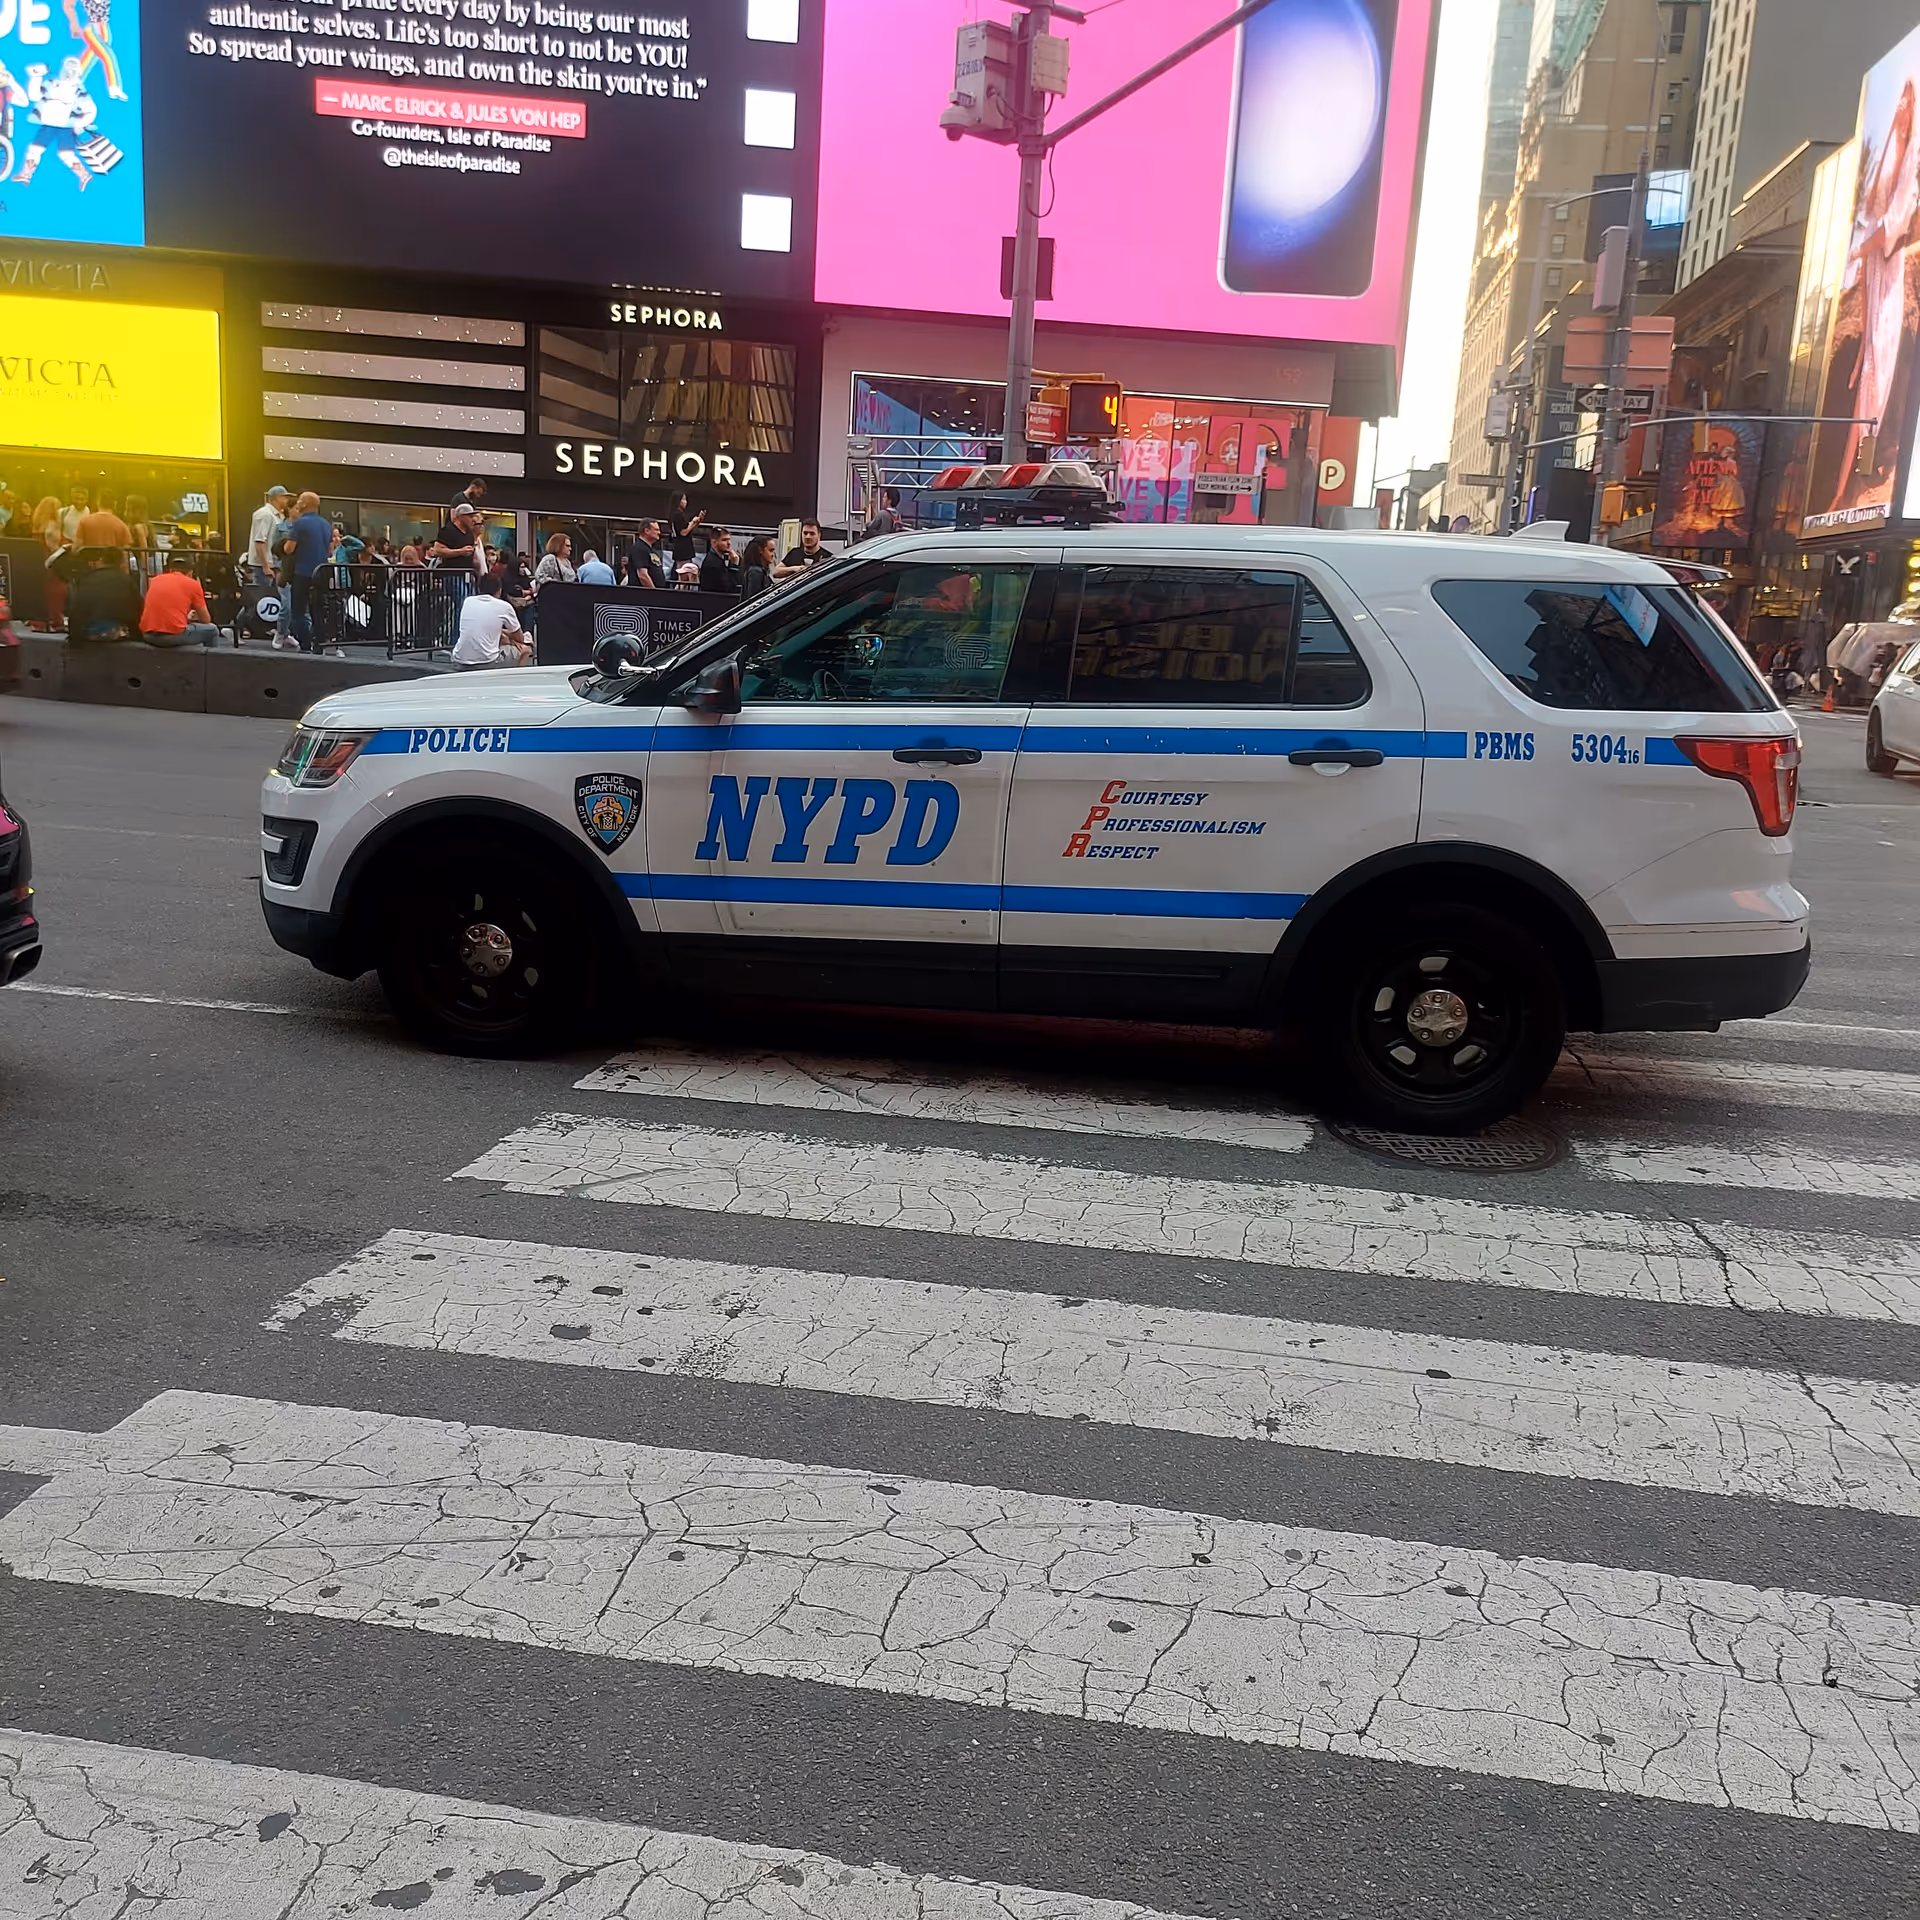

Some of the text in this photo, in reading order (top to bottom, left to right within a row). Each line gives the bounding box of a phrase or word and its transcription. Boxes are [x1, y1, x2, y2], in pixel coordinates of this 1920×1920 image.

[400, 0, 459, 21] every
[463, 0, 501, 25] day
[505, 0, 530, 28] by
[534, 1, 594, 34] being
[597, 15, 635, 33] our
[638, 15, 690, 39] most
[209, 5, 310, 33] authentic
[313, 12, 380, 41] selves.
[444, 26, 479, 49] too
[483, 28, 539, 56] short
[543, 35, 565, 58] to
[568, 38, 604, 61] not
[607, 38, 633, 64] be
[635, 43, 688, 69] YOU!
[188, 32, 217, 56] So
[220, 38, 292, 62] spread
[297, 47, 347, 68] your
[351, 45, 420, 77] wings,
[424, 55, 465, 79] and
[468, 62, 515, 84] own
[518, 61, 553, 87] the
[556, 65, 602, 92] skin
[342, 91, 392, 114] MARC
[395, 95, 447, 118] ELRICK
[450, 102, 464, 120] &
[466, 104, 508, 125] JULES
[510, 108, 548, 128] VON
[551, 111, 581, 130] HEP
[351, 118, 551, 153] Co-founders, Isle of Paradise
[383, 147, 521, 174] @theisleofparadise
[610, 303, 723, 330] SEPHORA
[1104, 396, 1118, 426] 4
[1586, 395, 1609, 407] ONE
[555, 442, 765, 488] SEPHORA
[1324, 466, 1337, 484] P
[261, 602, 280, 616] JD
[657, 620, 692, 632] TIMES
[411, 728, 507, 753] POLICE
[1474, 731, 1535, 761] PBMS
[579, 784, 638, 799] DEPARTMENT
[592, 775, 625, 785] POLICE
[578, 805, 597, 838] CITY OF
[616, 804, 638, 842] NEW YORK
[694, 774, 961, 866] NYPD
